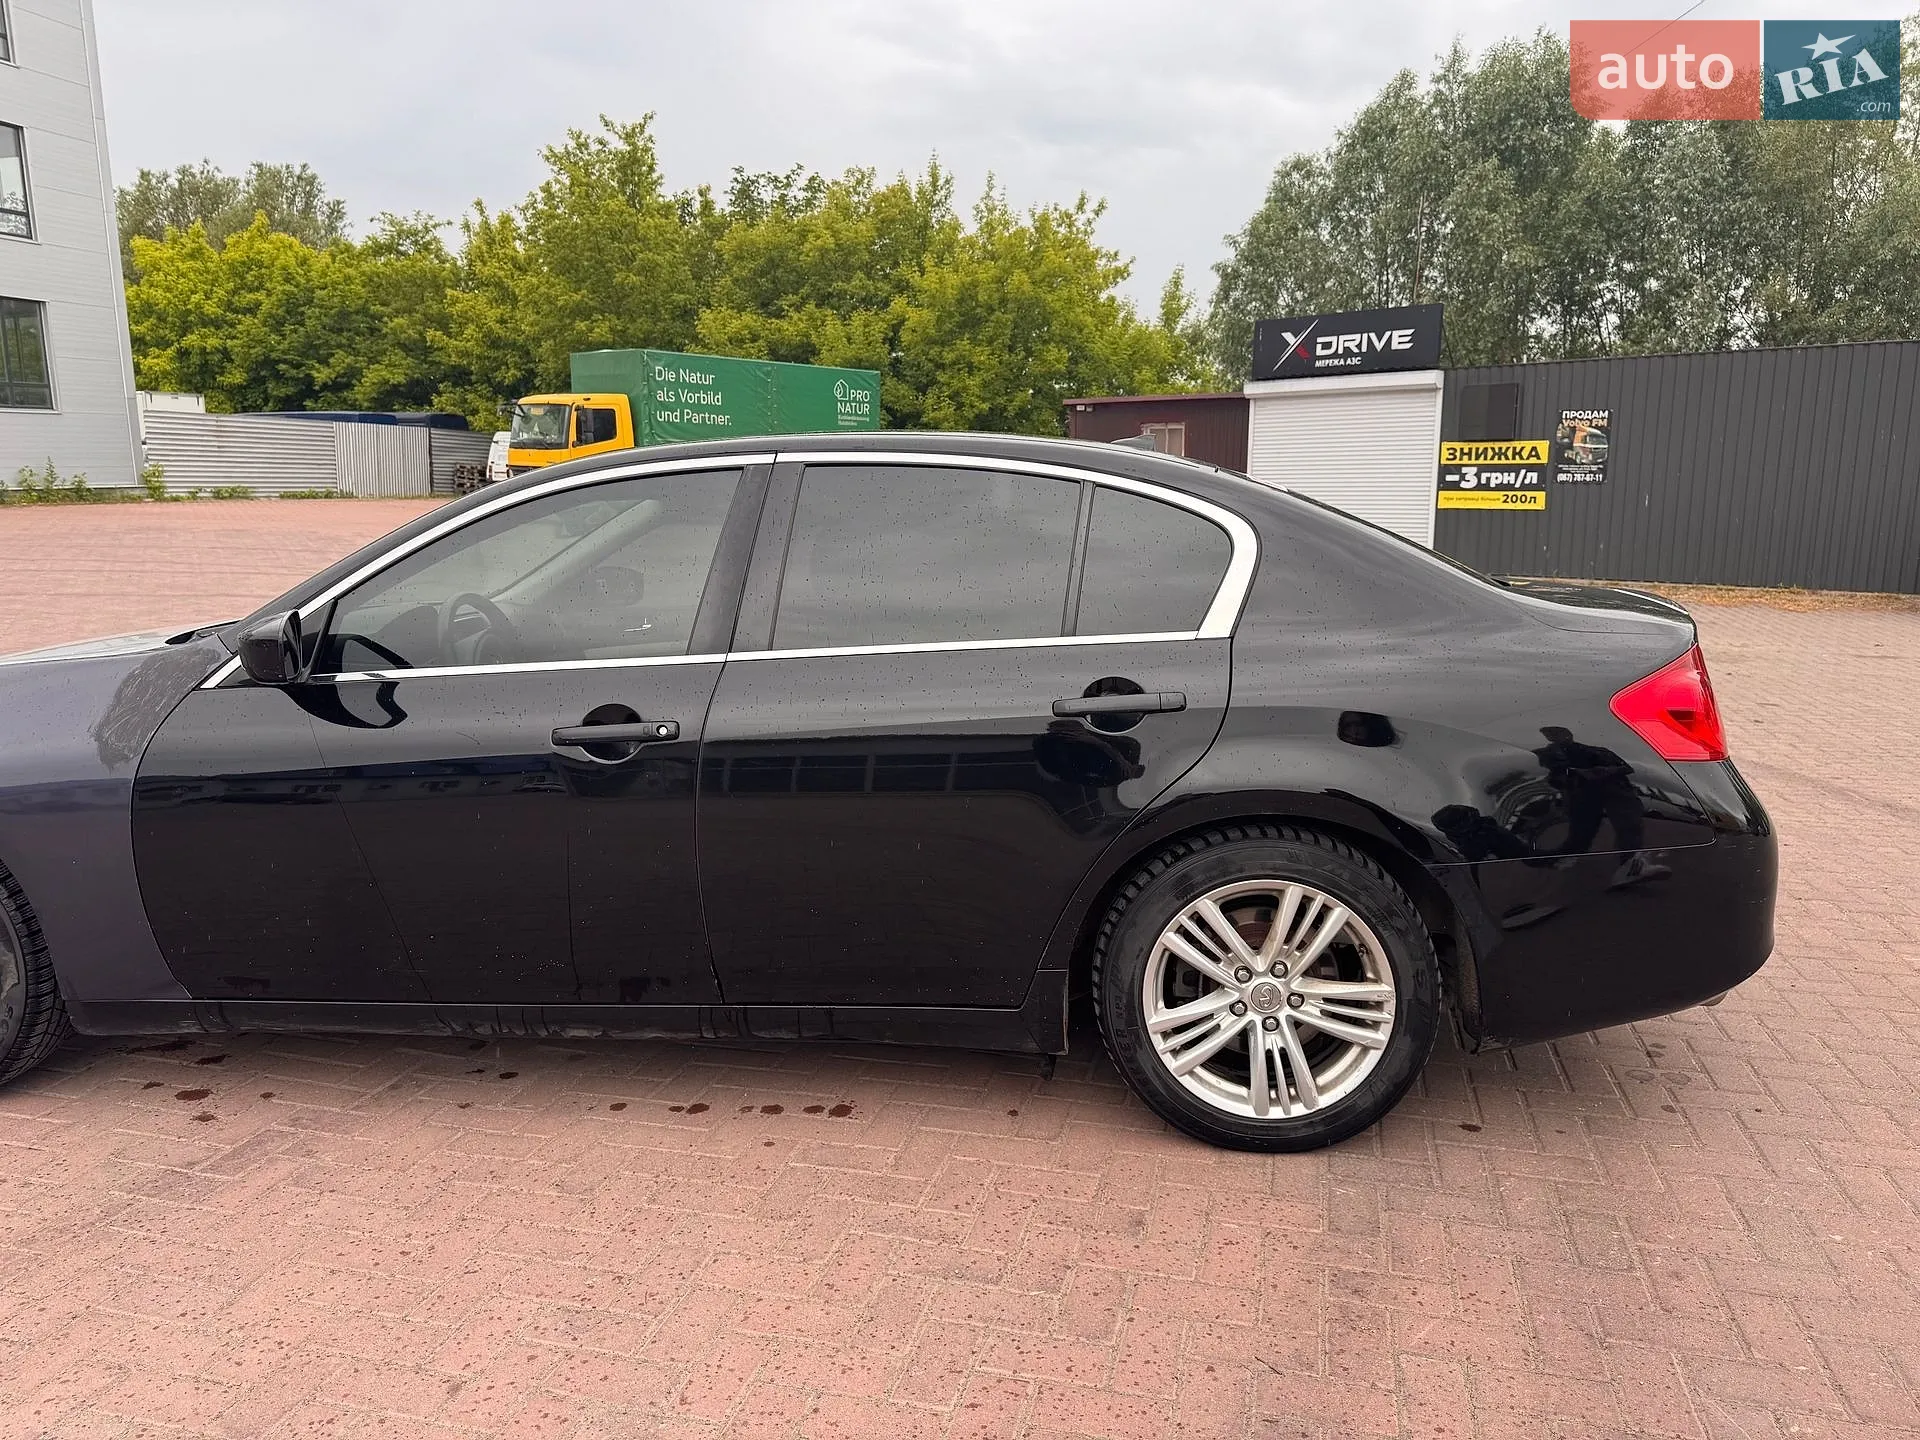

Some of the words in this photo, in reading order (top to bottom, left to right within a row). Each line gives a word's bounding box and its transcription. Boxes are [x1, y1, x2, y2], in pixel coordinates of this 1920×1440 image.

[1315, 328, 1416, 356] DRIVE
[1314, 358, 1345, 368] МЕРЕЖА
[1345, 356, 1362, 366] АЗС
[655, 366, 676, 382] Die
[679, 367, 715, 385] Natur
[656, 387, 676, 402] als
[678, 388, 722, 406] Vorbild
[850, 389, 870, 402] PRO
[837, 402, 870, 415] NATUR
[1562, 410, 1609, 420] ПРОДАМ
[656, 408, 680, 423] und
[684, 409, 732, 426] Partner.
[1562, 419, 1590, 428] Volvo
[1591, 418, 1608, 427] FM
[1445, 445, 1541, 461] ЗНИЖКА
[1445, 467, 1478, 489] -3
[1480, 468, 1538, 488] грн/л
[1502, 494, 1537, 504] 200л
